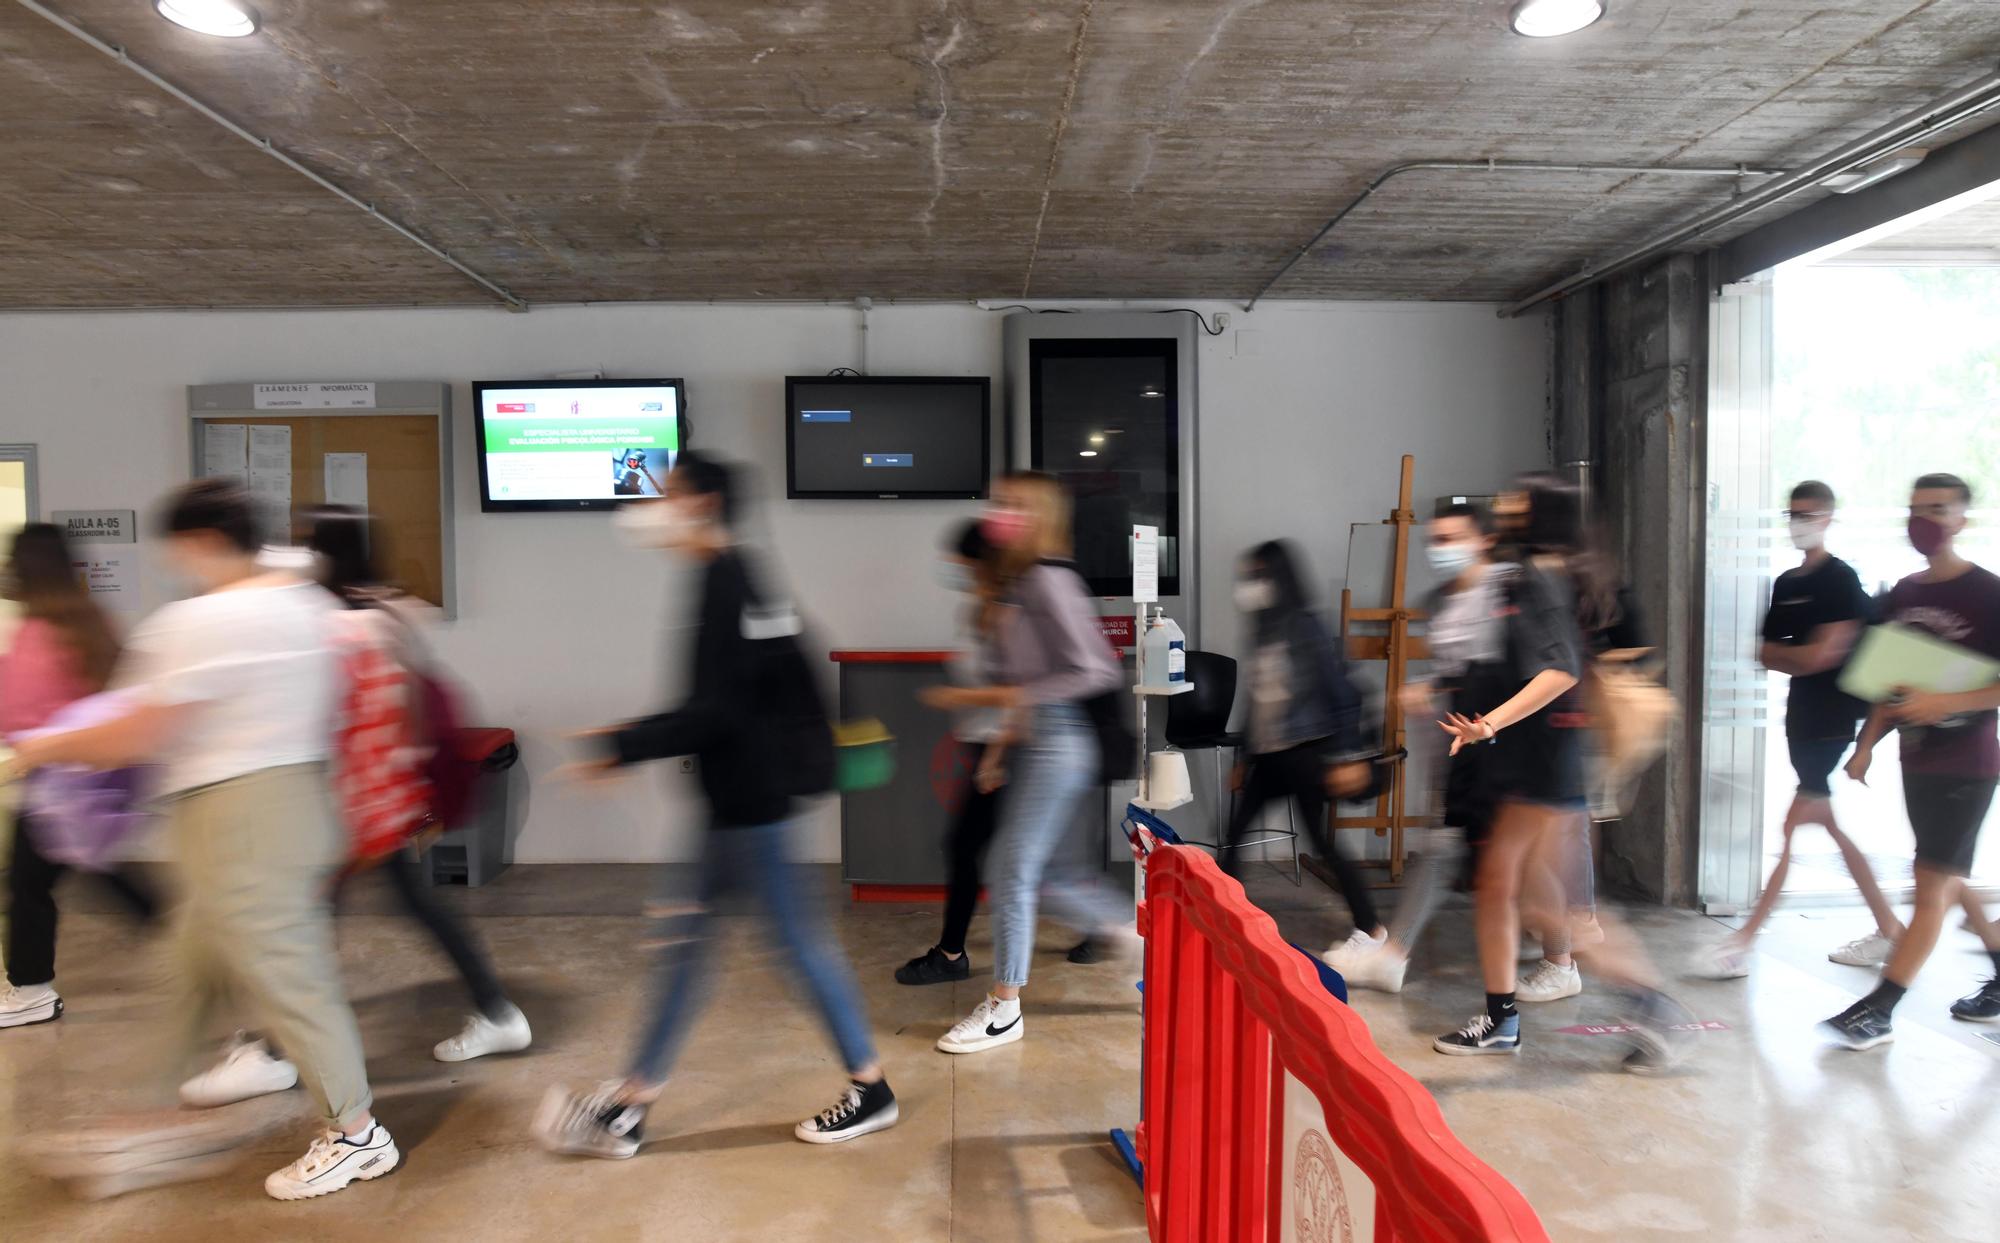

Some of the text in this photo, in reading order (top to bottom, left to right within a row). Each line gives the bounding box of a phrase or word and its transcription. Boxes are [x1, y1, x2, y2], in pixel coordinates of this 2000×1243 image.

[68, 518, 120, 529] AULA A-05
[1119, 621, 1129, 629] DE
